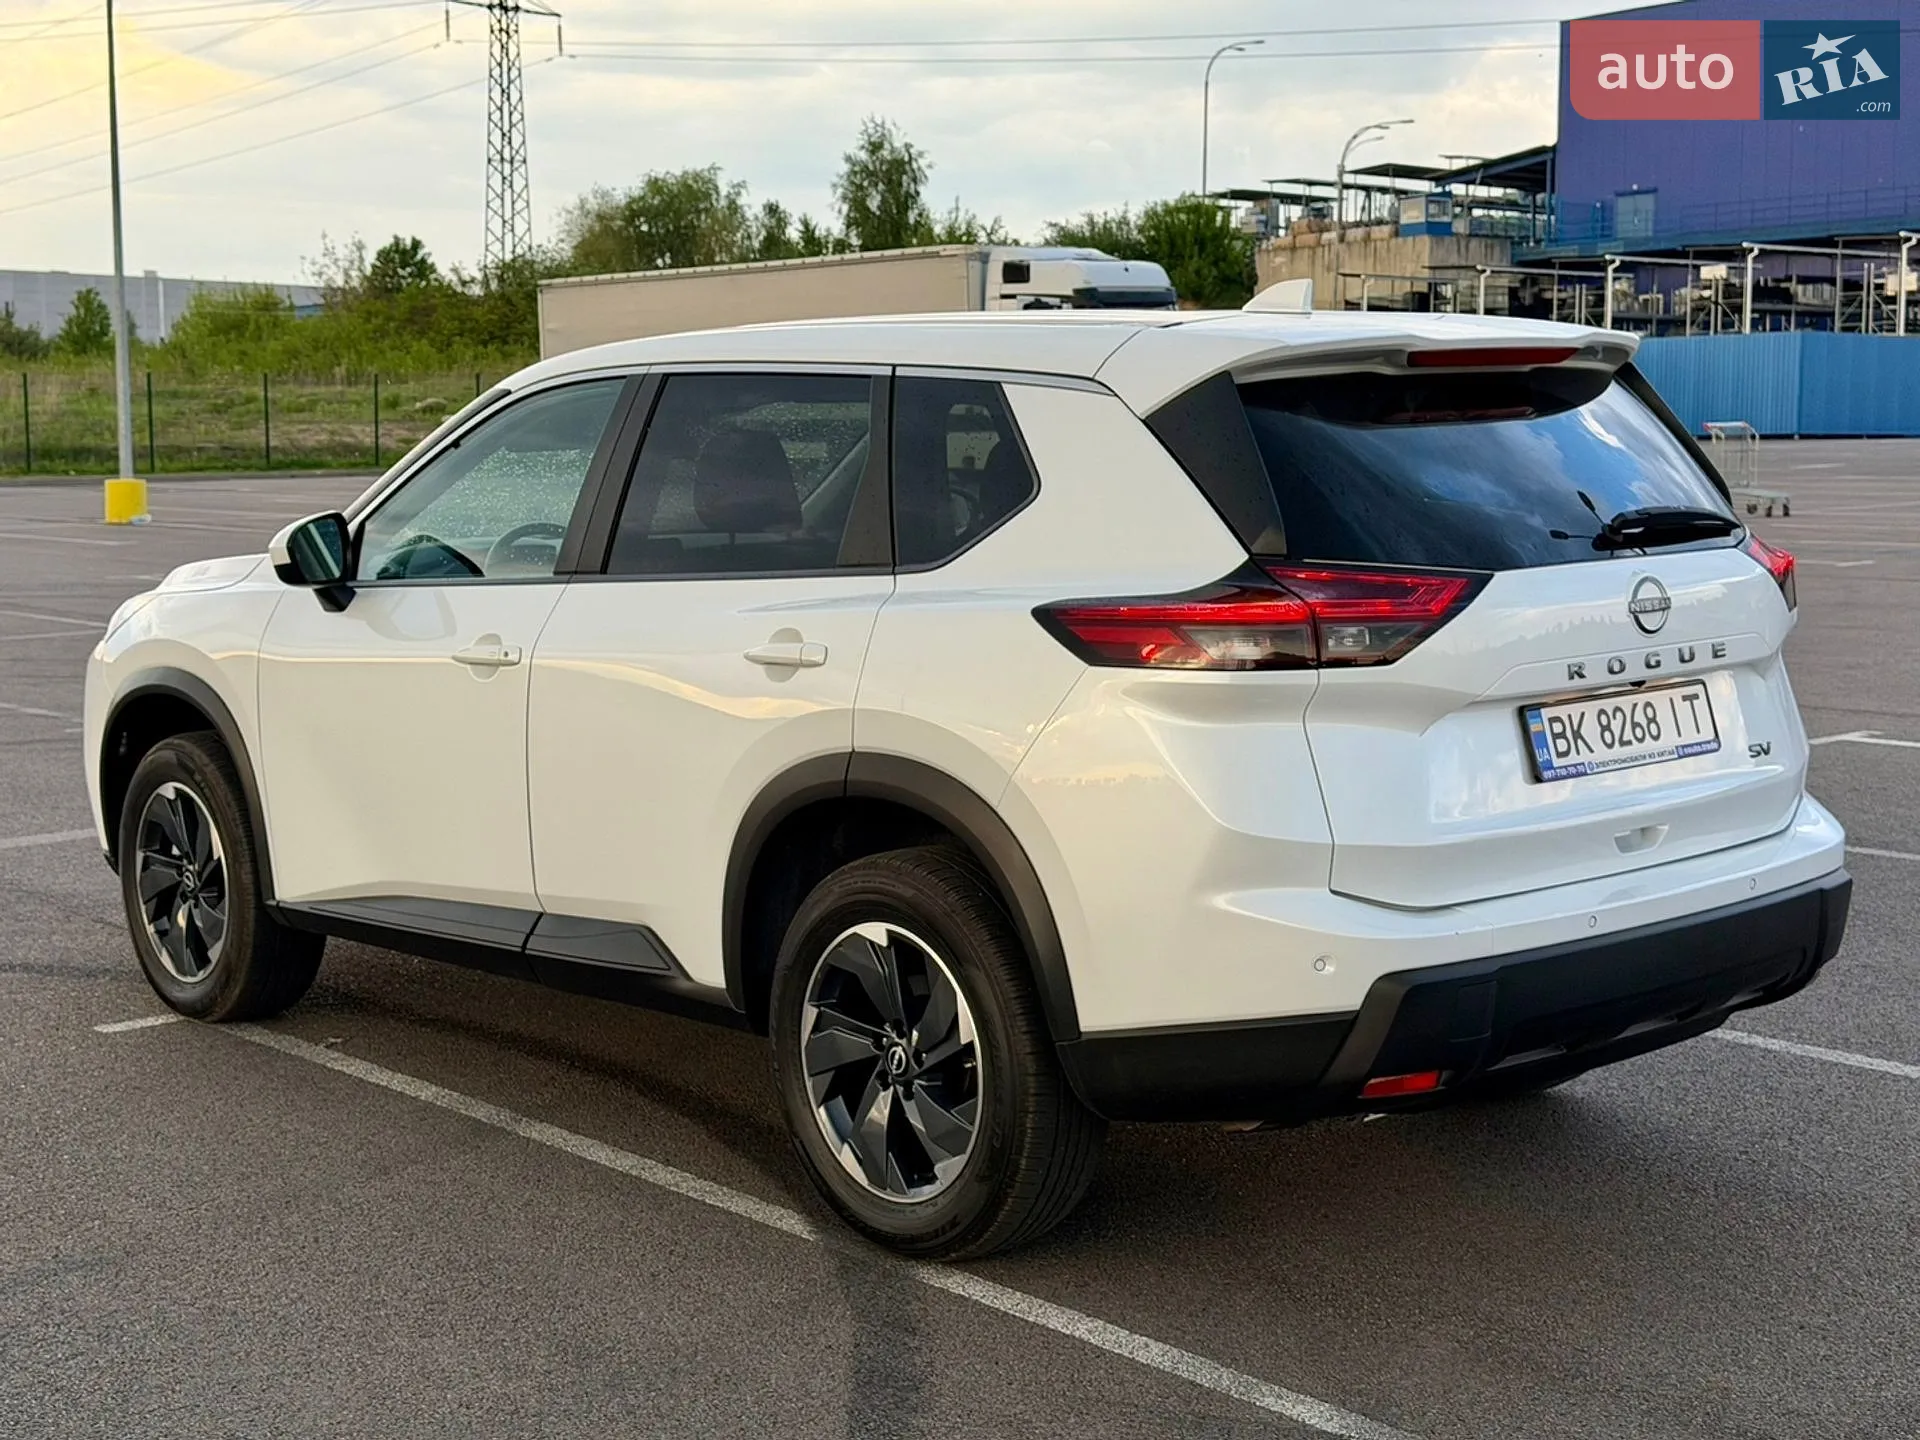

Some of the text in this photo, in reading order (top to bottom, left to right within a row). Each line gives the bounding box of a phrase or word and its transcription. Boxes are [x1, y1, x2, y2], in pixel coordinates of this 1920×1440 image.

[1630, 597, 1671, 613] NISSAN
[1567, 642, 1727, 680] ROGUE
[1547, 693, 1701, 759] BK 8268 IT
[1537, 747, 1551, 761] UA
[1748, 741, 1772, 758] SV
